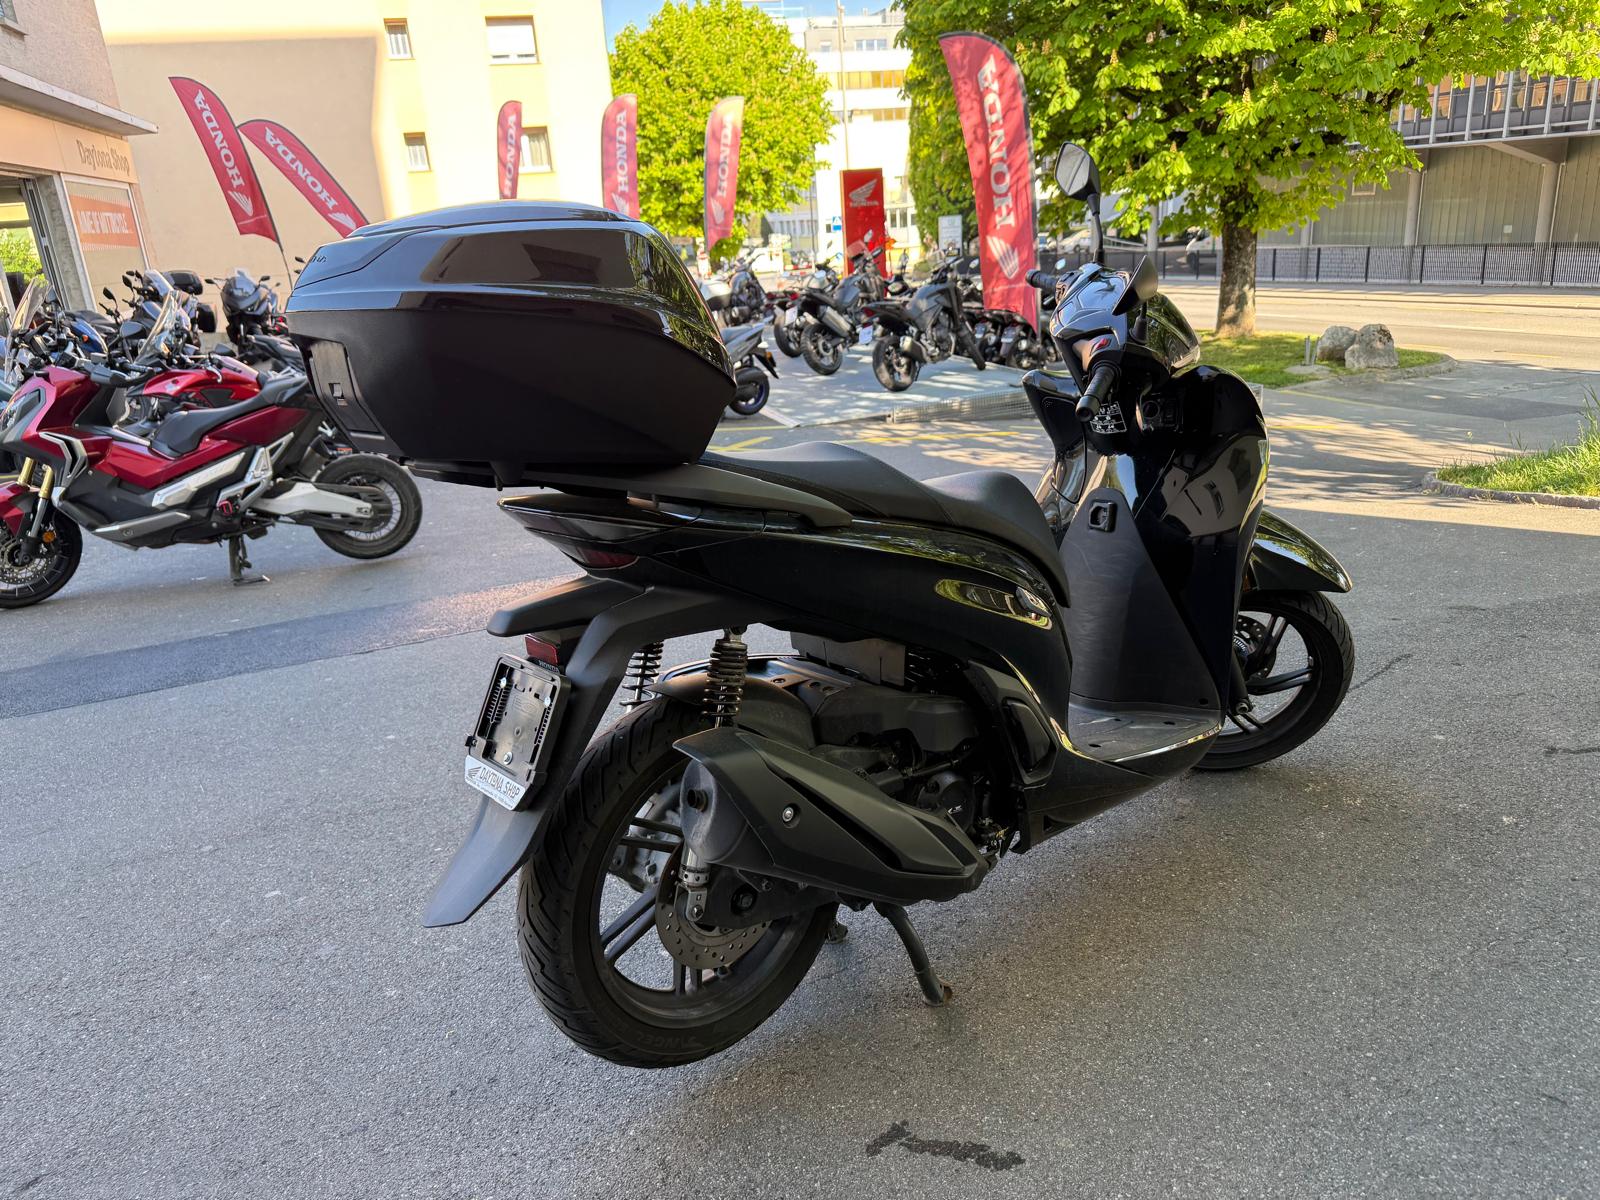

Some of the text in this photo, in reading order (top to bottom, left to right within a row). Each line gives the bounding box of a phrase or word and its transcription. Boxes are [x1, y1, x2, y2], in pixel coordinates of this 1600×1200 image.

[76, 139, 130, 176] Daytona Shop
[194, 89, 243, 189] HONDA
[264, 126, 339, 210] HONDA
[503, 114, 517, 197] HONDA
[614, 109, 629, 193] HONDA
[717, 113, 733, 197] HONDA
[977, 54, 1015, 229] HONDA
[479, 766, 504, 794] DAYTONA
[503, 781, 521, 799] SHOP
